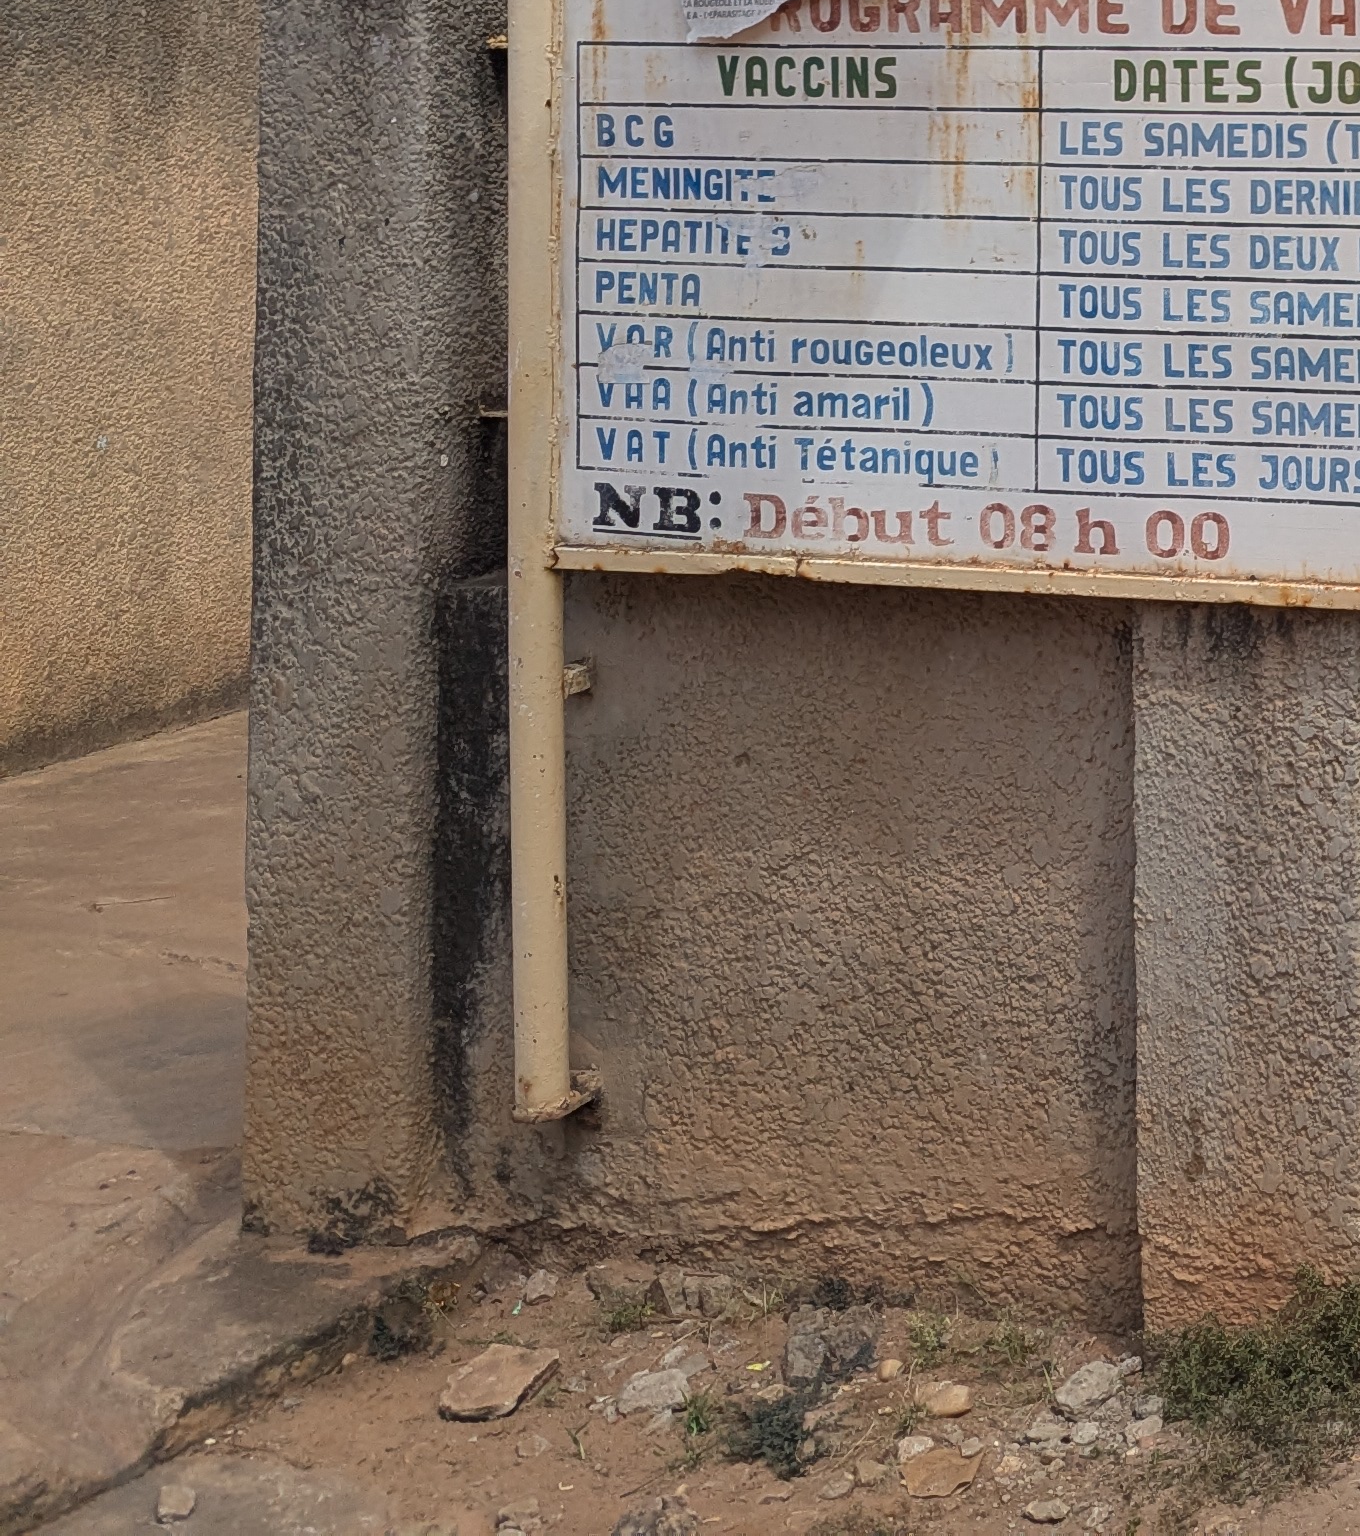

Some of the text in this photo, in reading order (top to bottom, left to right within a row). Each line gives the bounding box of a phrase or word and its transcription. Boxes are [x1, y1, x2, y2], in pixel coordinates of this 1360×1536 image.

[717, 54, 898, 101] VACCINS
[1114, 57, 1262, 104] DATES
[1058, 120, 1124, 157] LES
[1144, 121, 1310, 160] SAMEDIS
[1059, 174, 1142, 212] TOUS
[1163, 177, 1231, 214] LES
[1058, 229, 1142, 268] TOUS
[1163, 232, 1231, 269] LES
[1250, 235, 1341, 273] DEUX
[595, 269, 701, 307] PENTA
[1057, 283, 1143, 322] TOUS
[1163, 287, 1232, 325] LES
[687, 321, 776, 363] (Anti
[1056, 338, 1143, 377] TOUS
[1164, 342, 1234, 380] LES
[687, 377, 779, 417] (Anti
[1056, 393, 1144, 432] TOUS
[1165, 396, 1234, 434] LES
[595, 426, 671, 464] VAT
[687, 427, 778, 471] (Anti
[1056, 448, 1145, 487] TOUS
[1166, 451, 1236, 488] LES
[592, 481, 1231, 561] NB: Début 08 h 00
